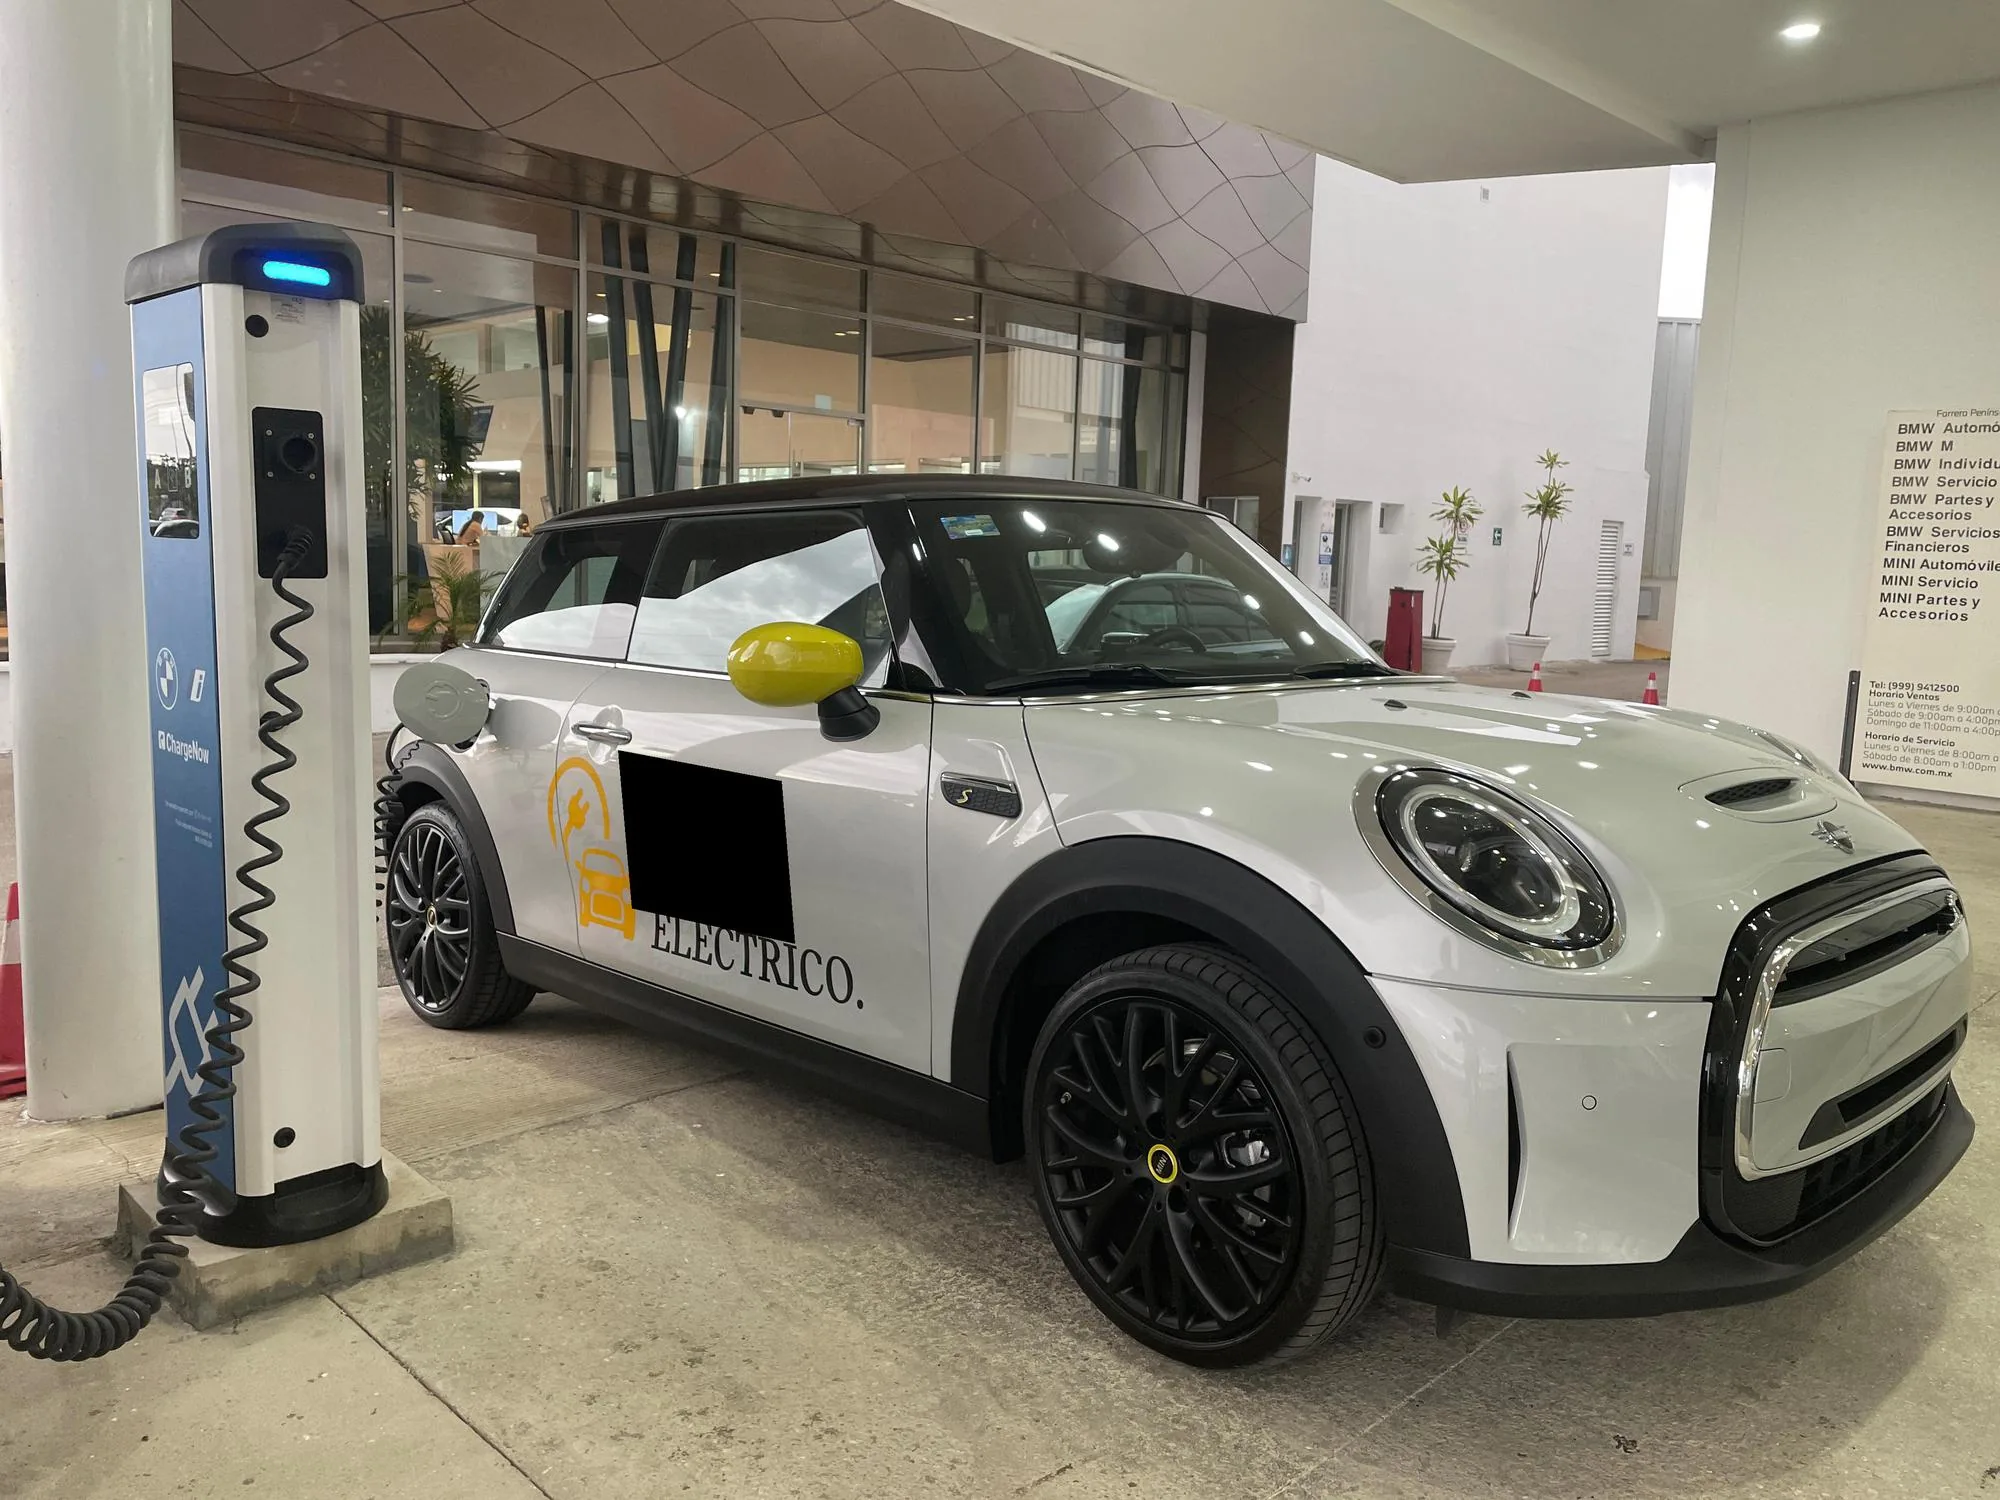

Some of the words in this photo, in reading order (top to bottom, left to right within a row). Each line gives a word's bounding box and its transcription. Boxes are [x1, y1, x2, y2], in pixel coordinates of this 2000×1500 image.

[1898, 423, 1935, 434] BMW
[1943, 421, 2000, 433] Automó
[1896, 441, 1933, 451] BMW
[1941, 440, 1954, 451] M
[1894, 458, 1931, 469] BMW
[1892, 476, 1929, 487] BMW
[1936, 476, 1998, 488] Servicio
[1890, 494, 1927, 505] BMW
[1934, 494, 1983, 505] Partes
[1985, 497, 1994, 508] y
[1888, 509, 1972, 521] Accesorios
[1886, 526, 1924, 537] BMW
[1931, 527, 2000, 539] Servicios
[1885, 541, 1970, 553] Financieros
[1883, 558, 1916, 569] MINI
[1920, 559, 2000, 572] Automóvile
[1881, 575, 1914, 587] MINI
[1917, 576, 1979, 589] Servicio
[1879, 592, 1912, 604] MINI
[1916, 593, 1968, 607] Partes
[1972, 598, 1981, 609] y
[1878, 608, 1969, 622] Accesorios
[1868, 680, 1886, 689] Tel:
[1888, 681, 1915, 692] (999)
[1917, 683, 1960, 693] 9412500
[1869, 689, 1905, 699] Horario
[1906, 692, 1940, 701] Ventas
[1868, 699, 1896, 708] Lunes
[1866, 716, 1907, 729] Domingo
[1865, 731, 1900, 742] Horario
[1902, 735, 1914, 743] de
[1916, 735, 1956, 747] Servicio
[166, 732, 209, 764] ChargeNow
[1862, 762, 1953, 778] www.bmw.com.mx
